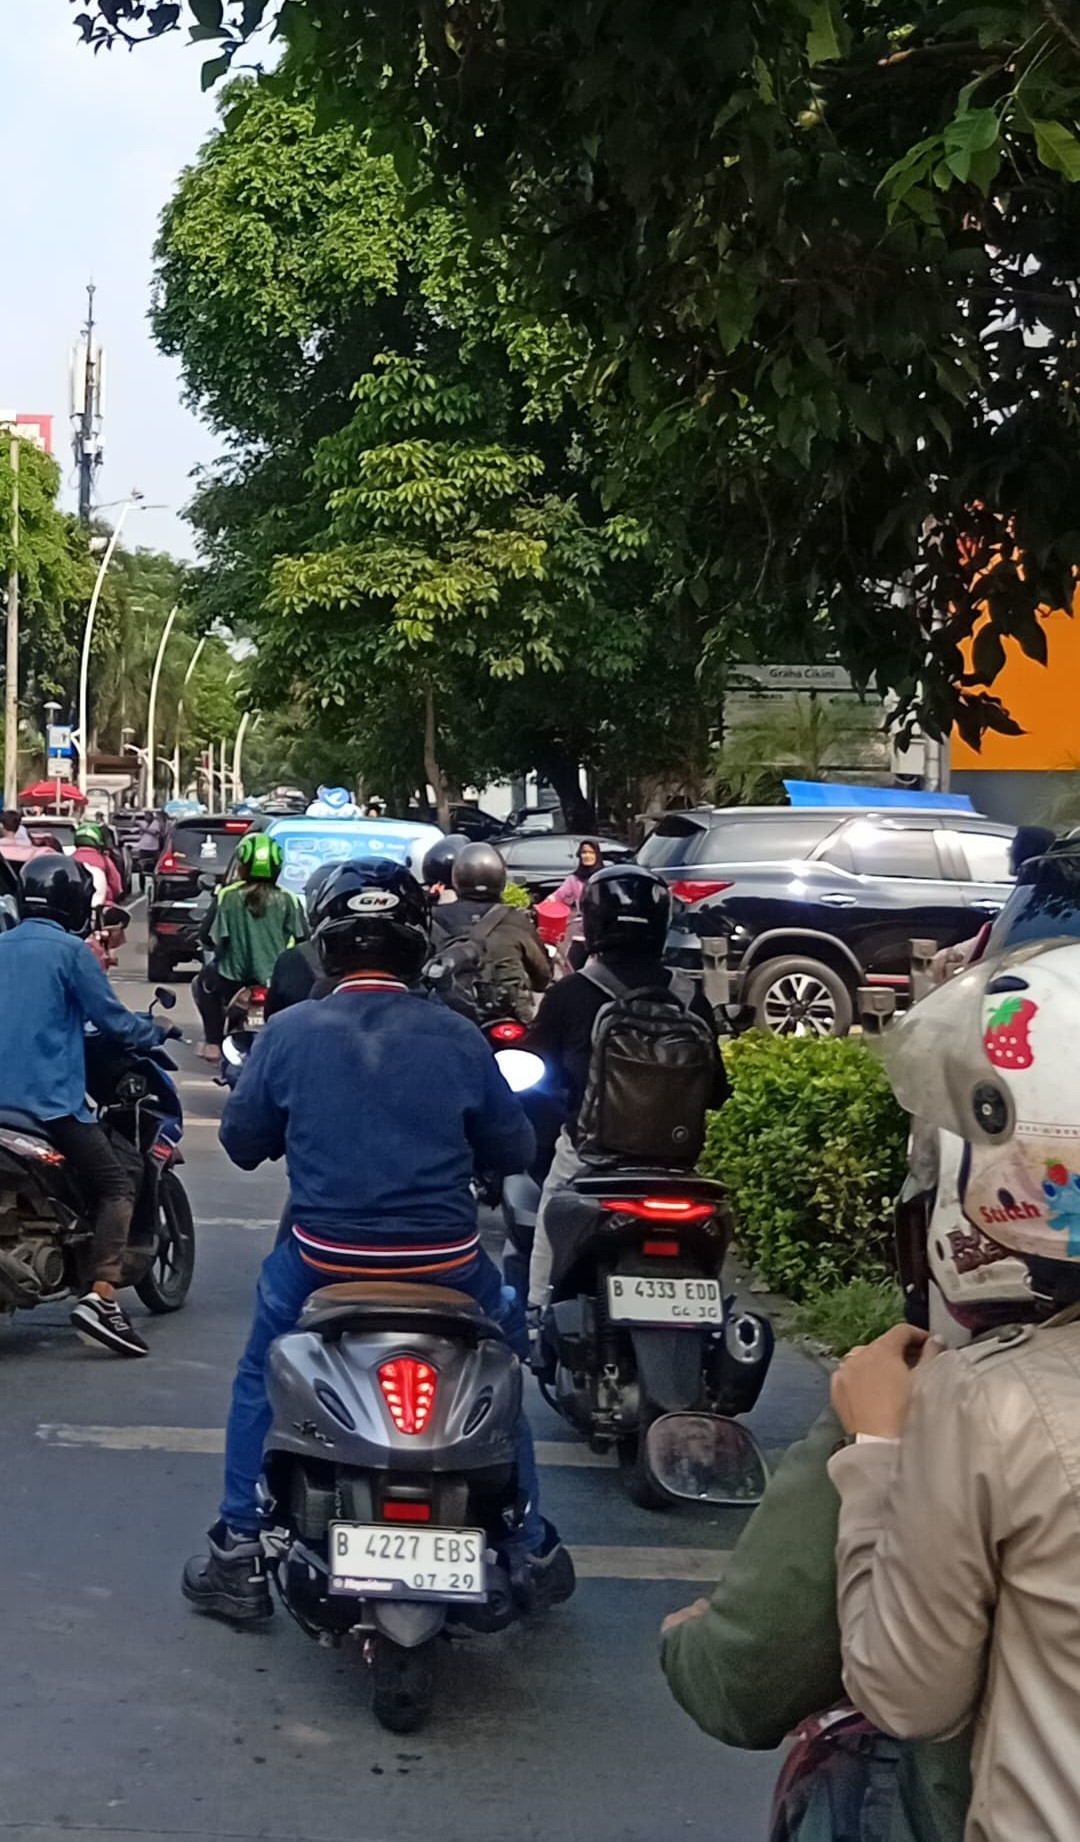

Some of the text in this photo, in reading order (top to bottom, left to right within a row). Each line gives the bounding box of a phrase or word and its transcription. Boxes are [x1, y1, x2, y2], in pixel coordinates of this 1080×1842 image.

[359, 897, 389, 905] GM
[979, 1201, 1042, 1224] Stitch
[613, 1280, 718, 1301] B 4333 EDD
[337, 1532, 476, 1563] B 4227 EBS
